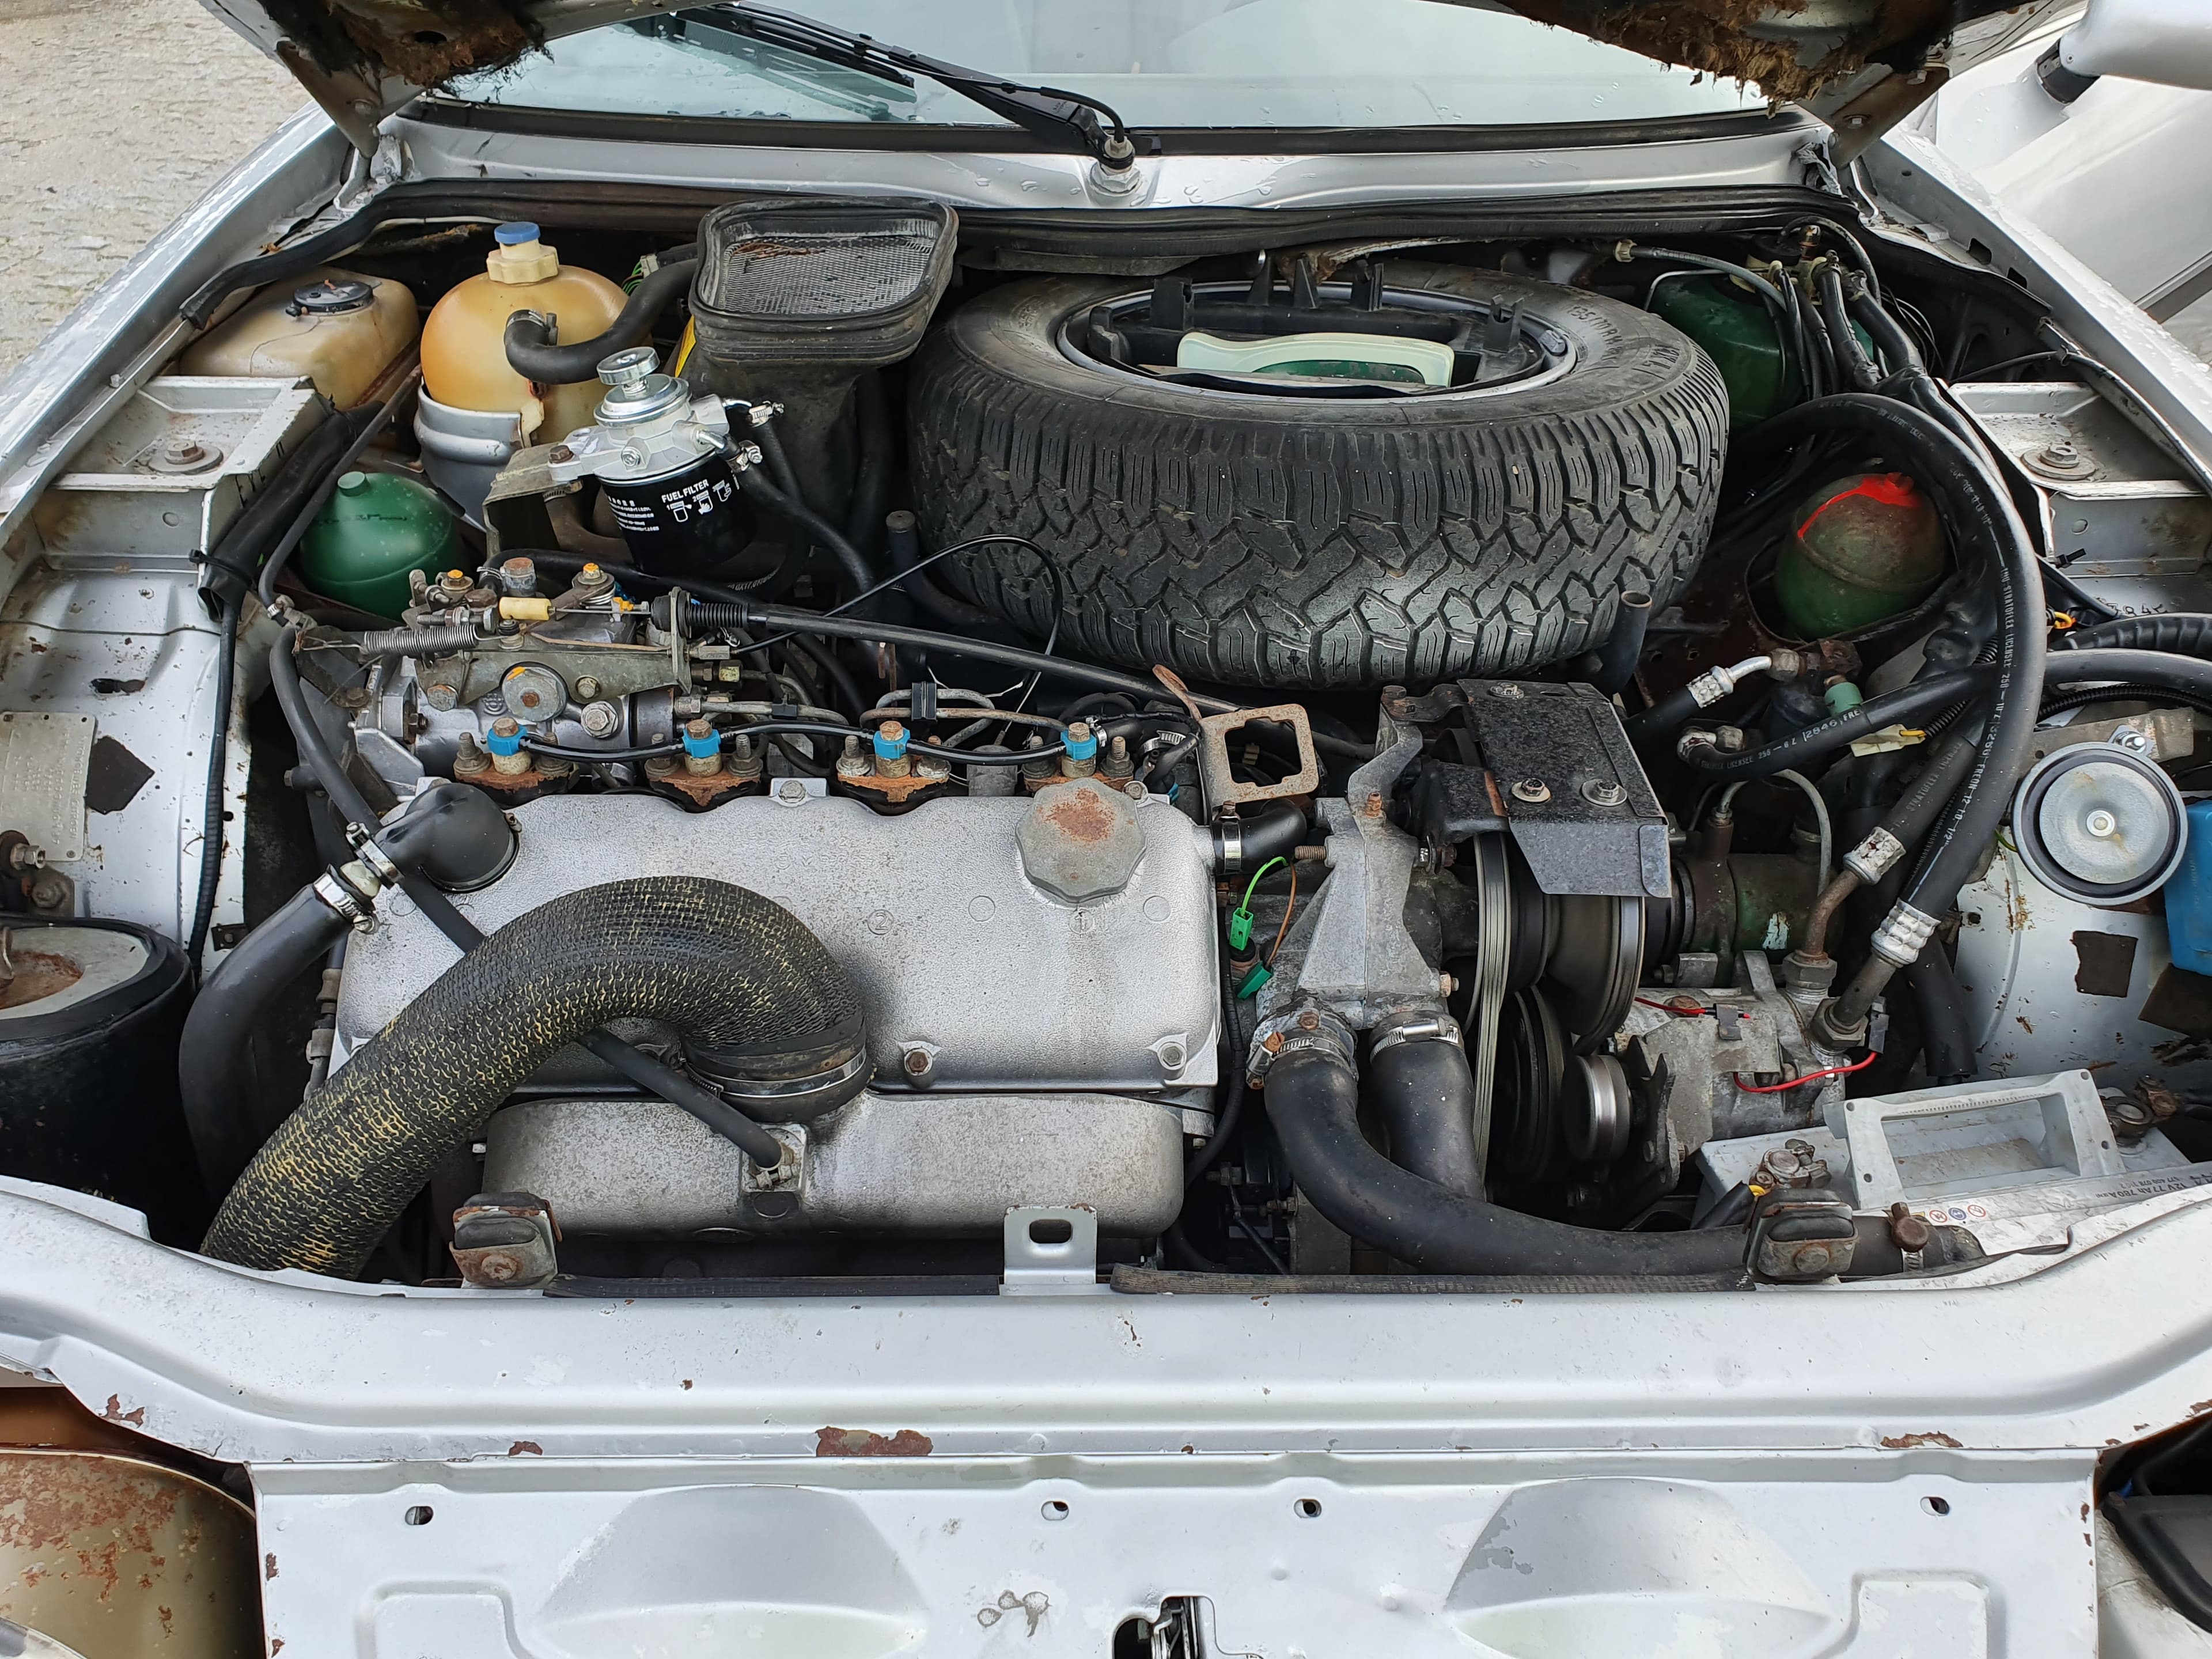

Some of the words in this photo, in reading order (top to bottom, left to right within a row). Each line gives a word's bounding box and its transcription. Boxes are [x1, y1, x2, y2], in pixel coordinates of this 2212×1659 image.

[661, 491, 684, 503] FUEL
[683, 479, 709, 496] FILTER
[1806, 719, 1838, 738] 2846
[1844, 709, 1862, 721] FRE
[1968, 763, 1986, 790] FREON
[1961, 794, 1972, 805] 12
[2168, 1182, 2187, 1191] 12V
